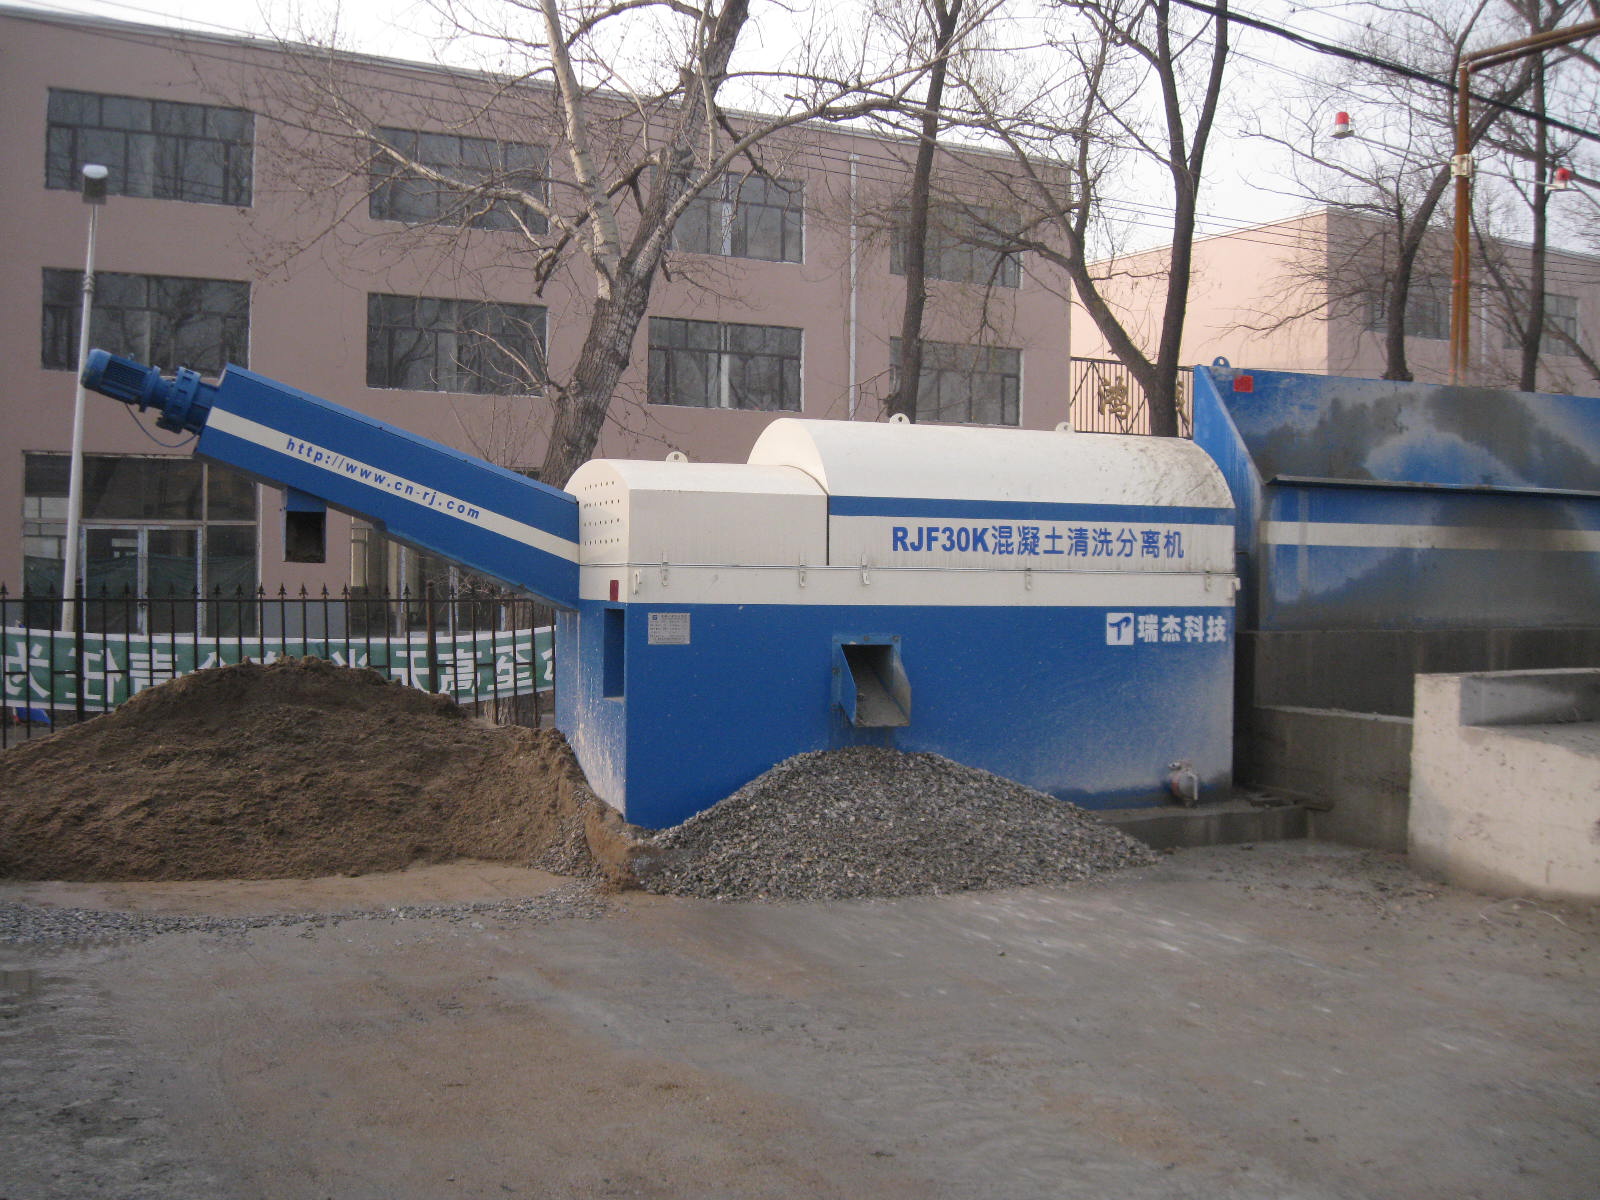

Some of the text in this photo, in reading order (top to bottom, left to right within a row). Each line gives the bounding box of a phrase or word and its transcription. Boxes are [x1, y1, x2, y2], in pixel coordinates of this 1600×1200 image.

[286, 438, 480, 519] http://www.cn-rj.com
[892, 525, 1185, 559] RJF30K混凝土清洗分离机
[1137, 614, 1227, 643] 瑞杰科技
